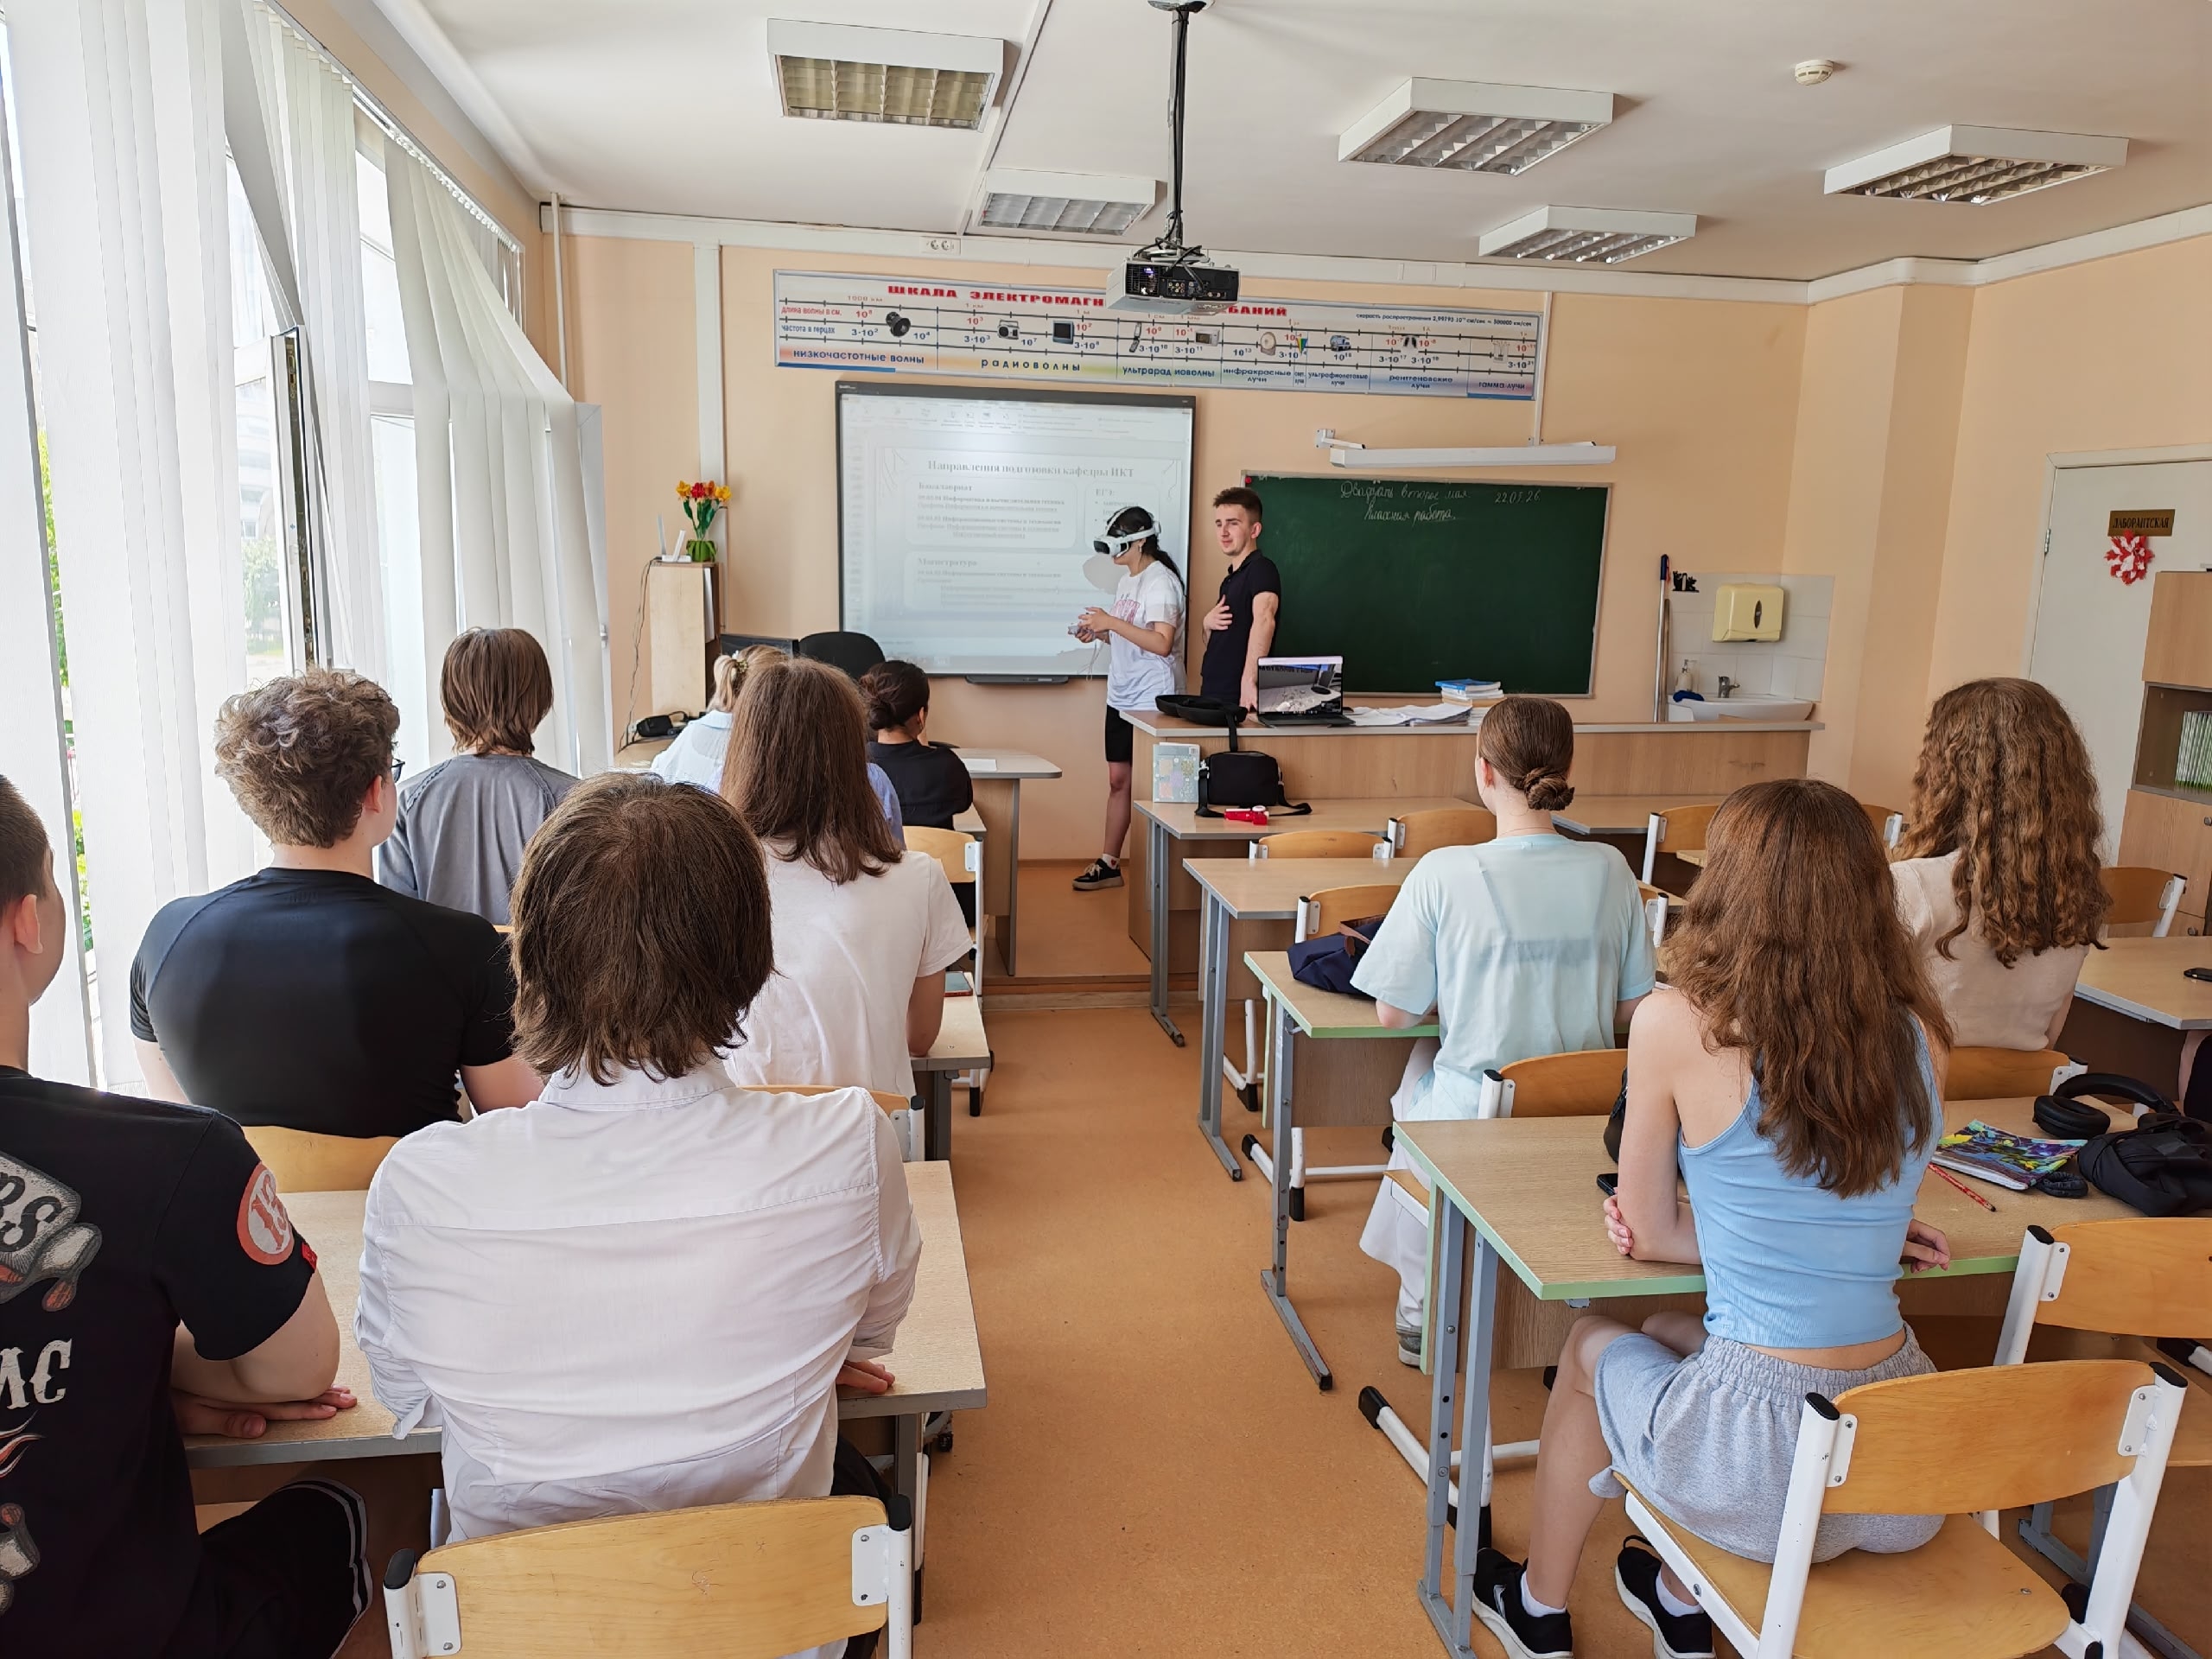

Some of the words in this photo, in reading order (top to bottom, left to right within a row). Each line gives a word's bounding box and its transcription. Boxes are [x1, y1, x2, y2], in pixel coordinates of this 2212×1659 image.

[887, 285, 957, 298] ШКАЛА
[969, 290, 1104, 307] ЭЛЕКТРОМАГН
[1227, 306, 1287, 317] БАНИЙ
[813, 327, 836, 335] герцах
[793, 350, 887, 362] низкочастотные
[890, 354, 925, 365] волны
[981, 359, 1080, 372] радиоволны
[1223, 367, 1292, 377] инфракрасные
[1307, 372, 1369, 380] ультрафиолетовые
[1389, 374, 1453, 383] рентгеновские
[927, 460, 1000, 474] Направления
[1001, 465, 1061, 475] подготовки
[1063, 467, 1109, 478] кафедры
[2113, 518, 2170, 529] ЛАБОРАНТСКАЯ
